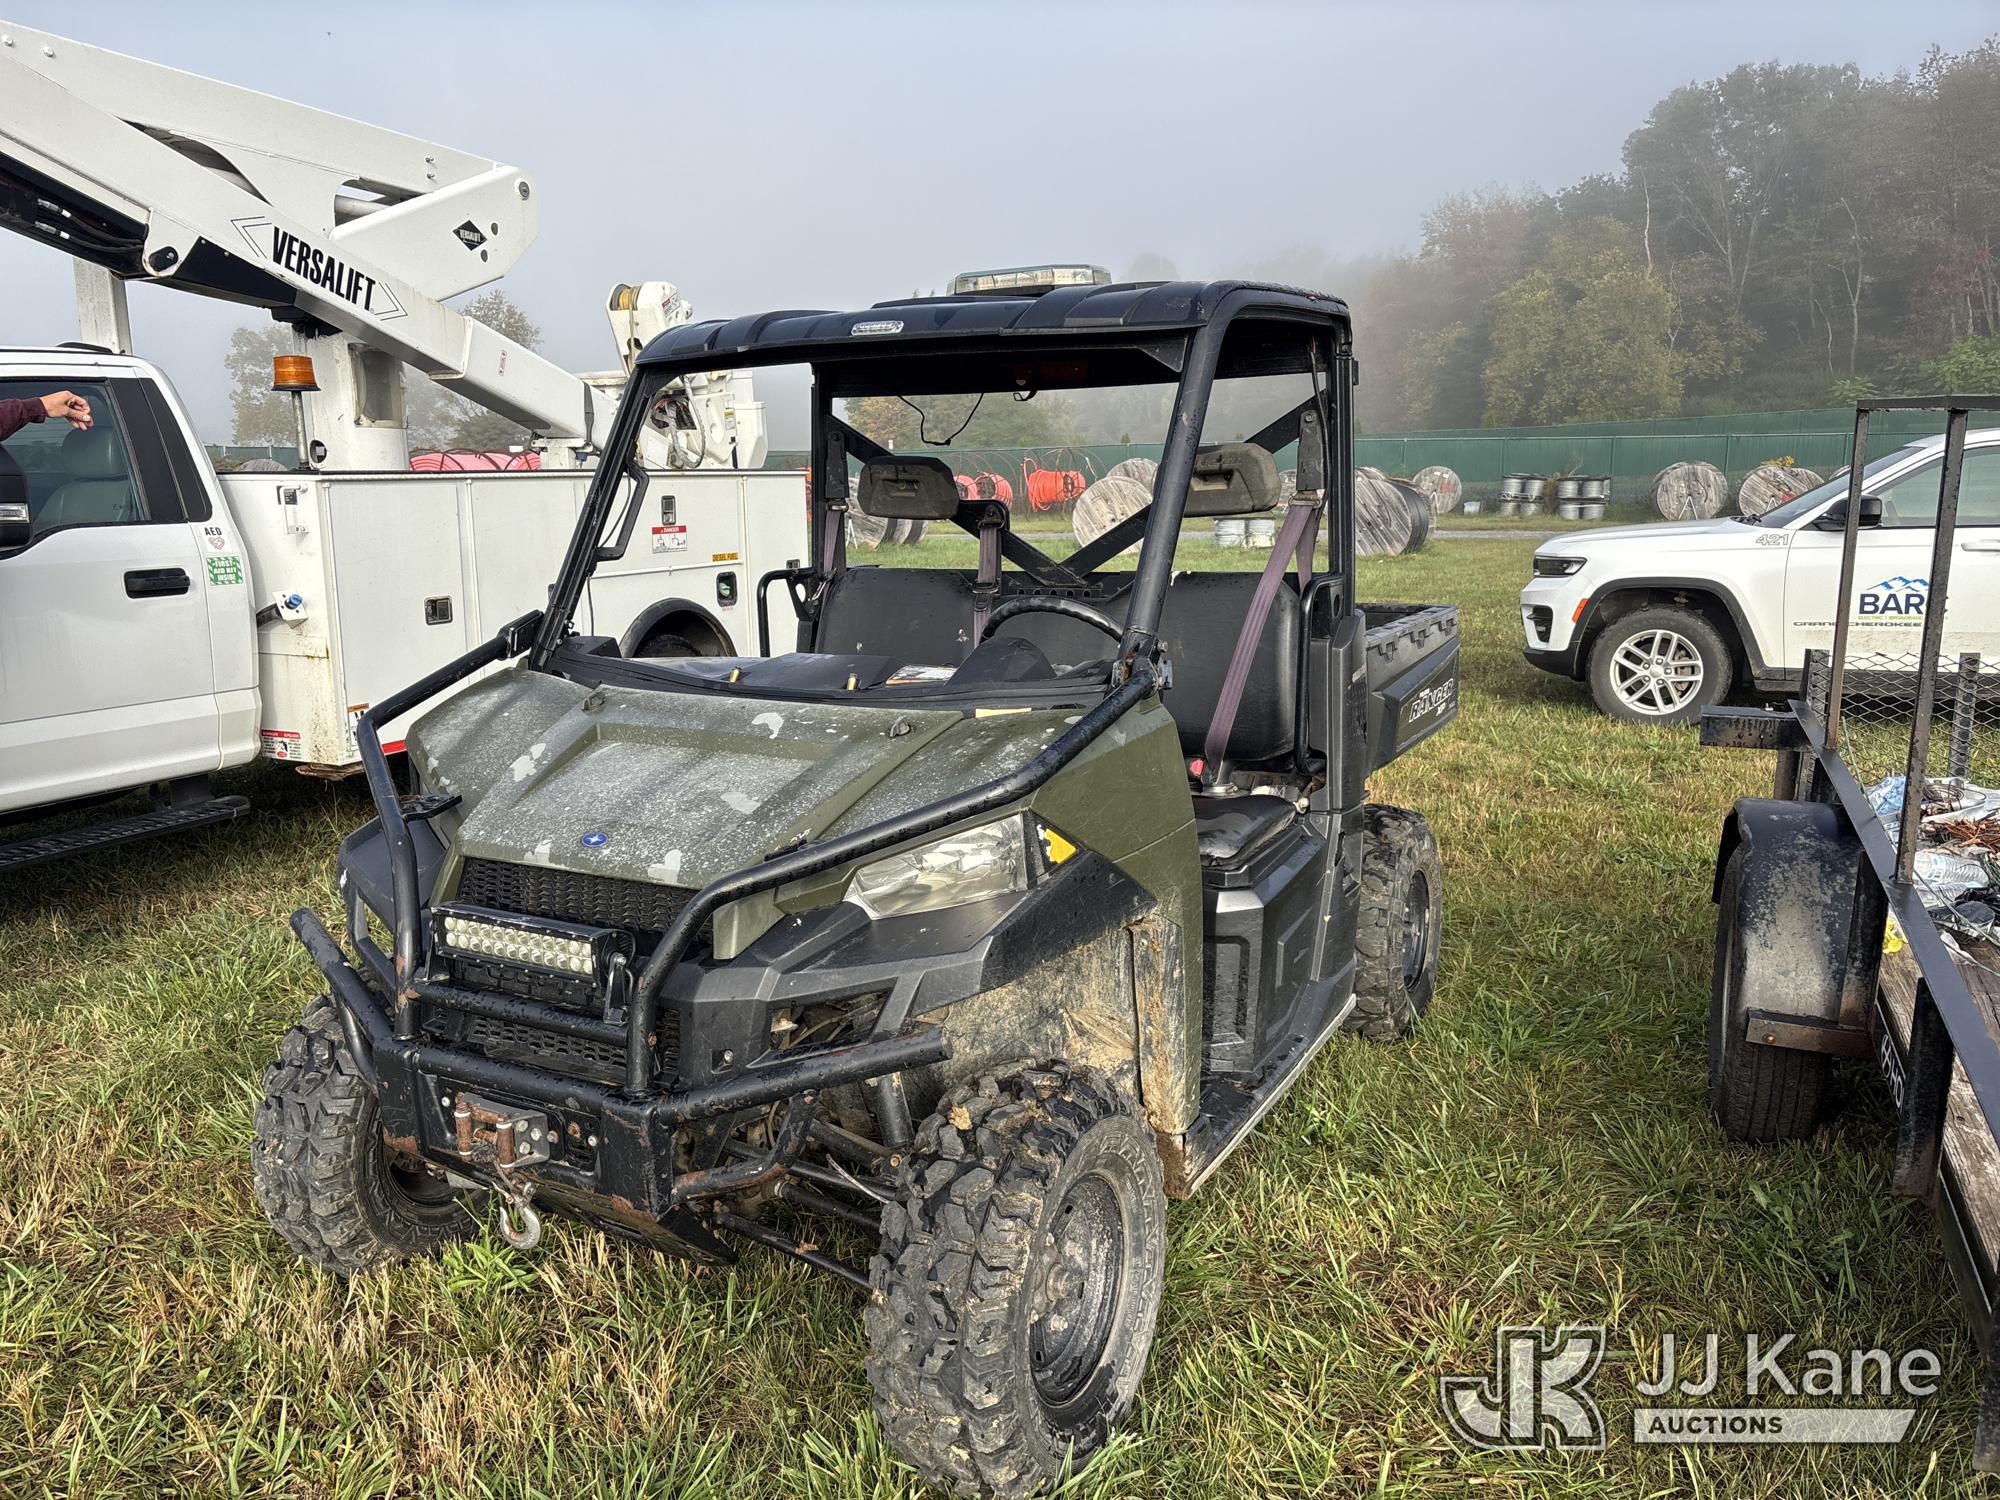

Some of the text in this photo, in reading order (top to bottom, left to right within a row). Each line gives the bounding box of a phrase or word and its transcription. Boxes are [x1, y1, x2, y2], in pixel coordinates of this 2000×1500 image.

[272, 225, 376, 312] VERSALIFT
[204, 527, 222, 536] AED
[1755, 533, 1789, 546] 421
[1859, 593, 1948, 615] BAR
[1408, 678, 1454, 723] RANGER
